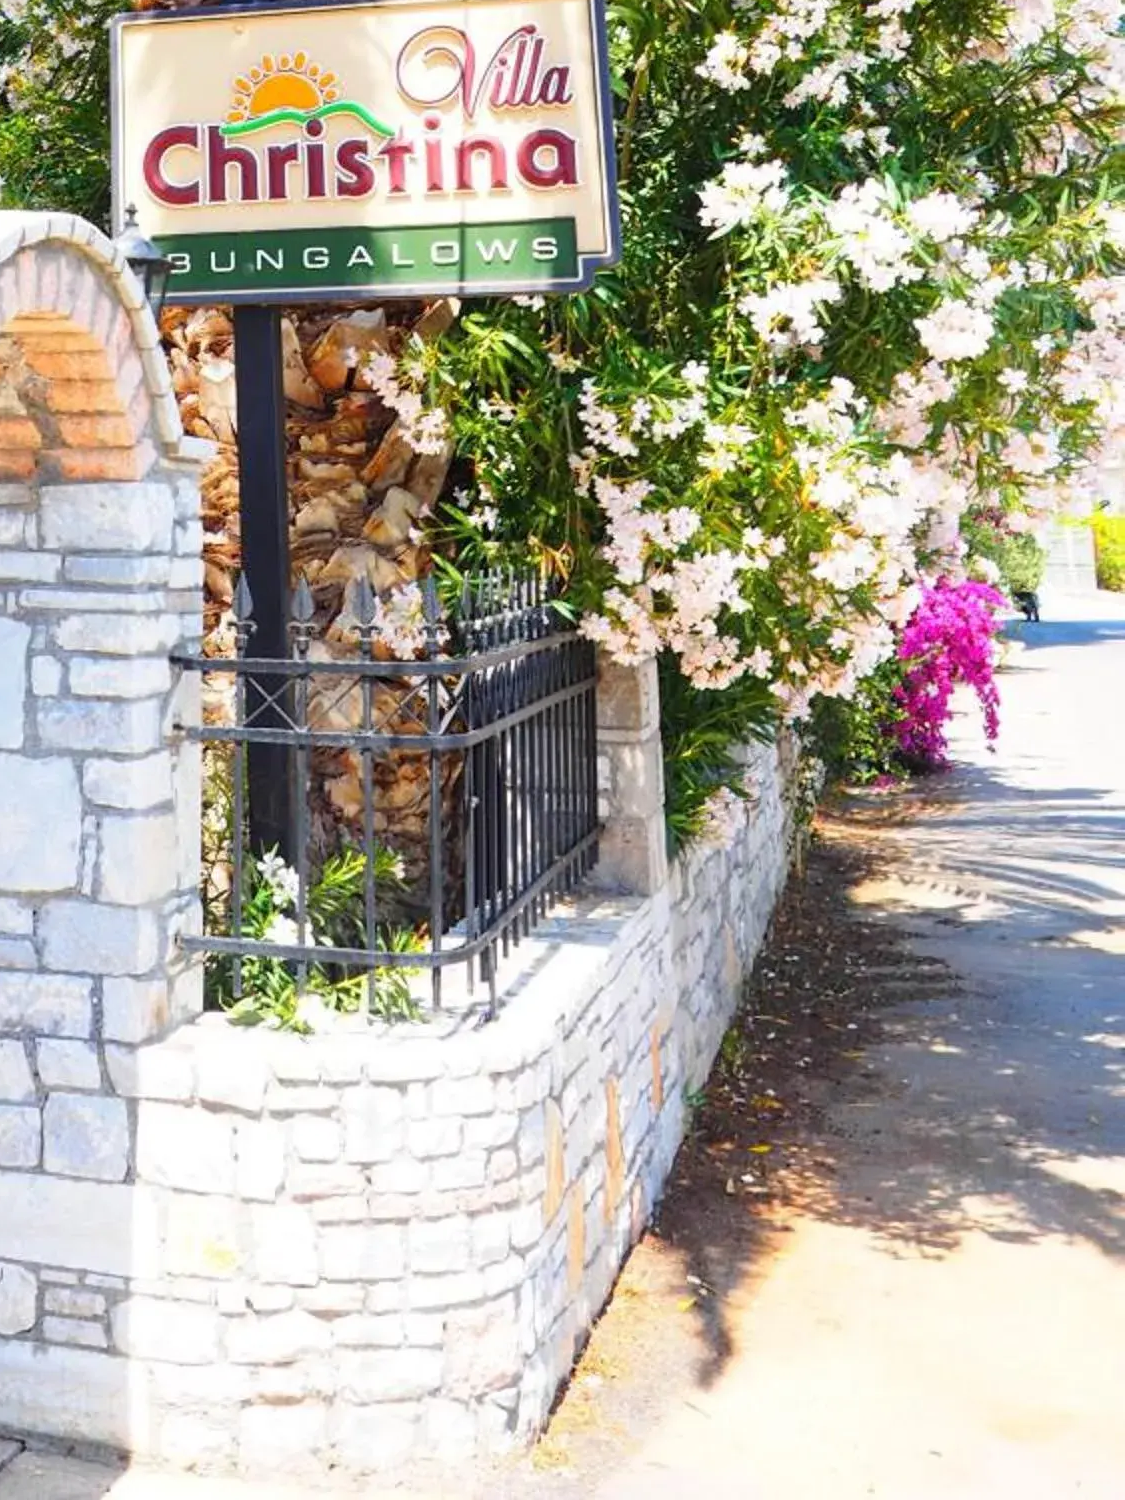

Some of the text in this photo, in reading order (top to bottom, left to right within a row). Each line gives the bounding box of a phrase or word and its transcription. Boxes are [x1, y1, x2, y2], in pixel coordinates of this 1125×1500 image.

[395, 23, 574, 121] Villa
[143, 115, 580, 206] Christina
[165, 237, 559, 275] BUNGALOWS
